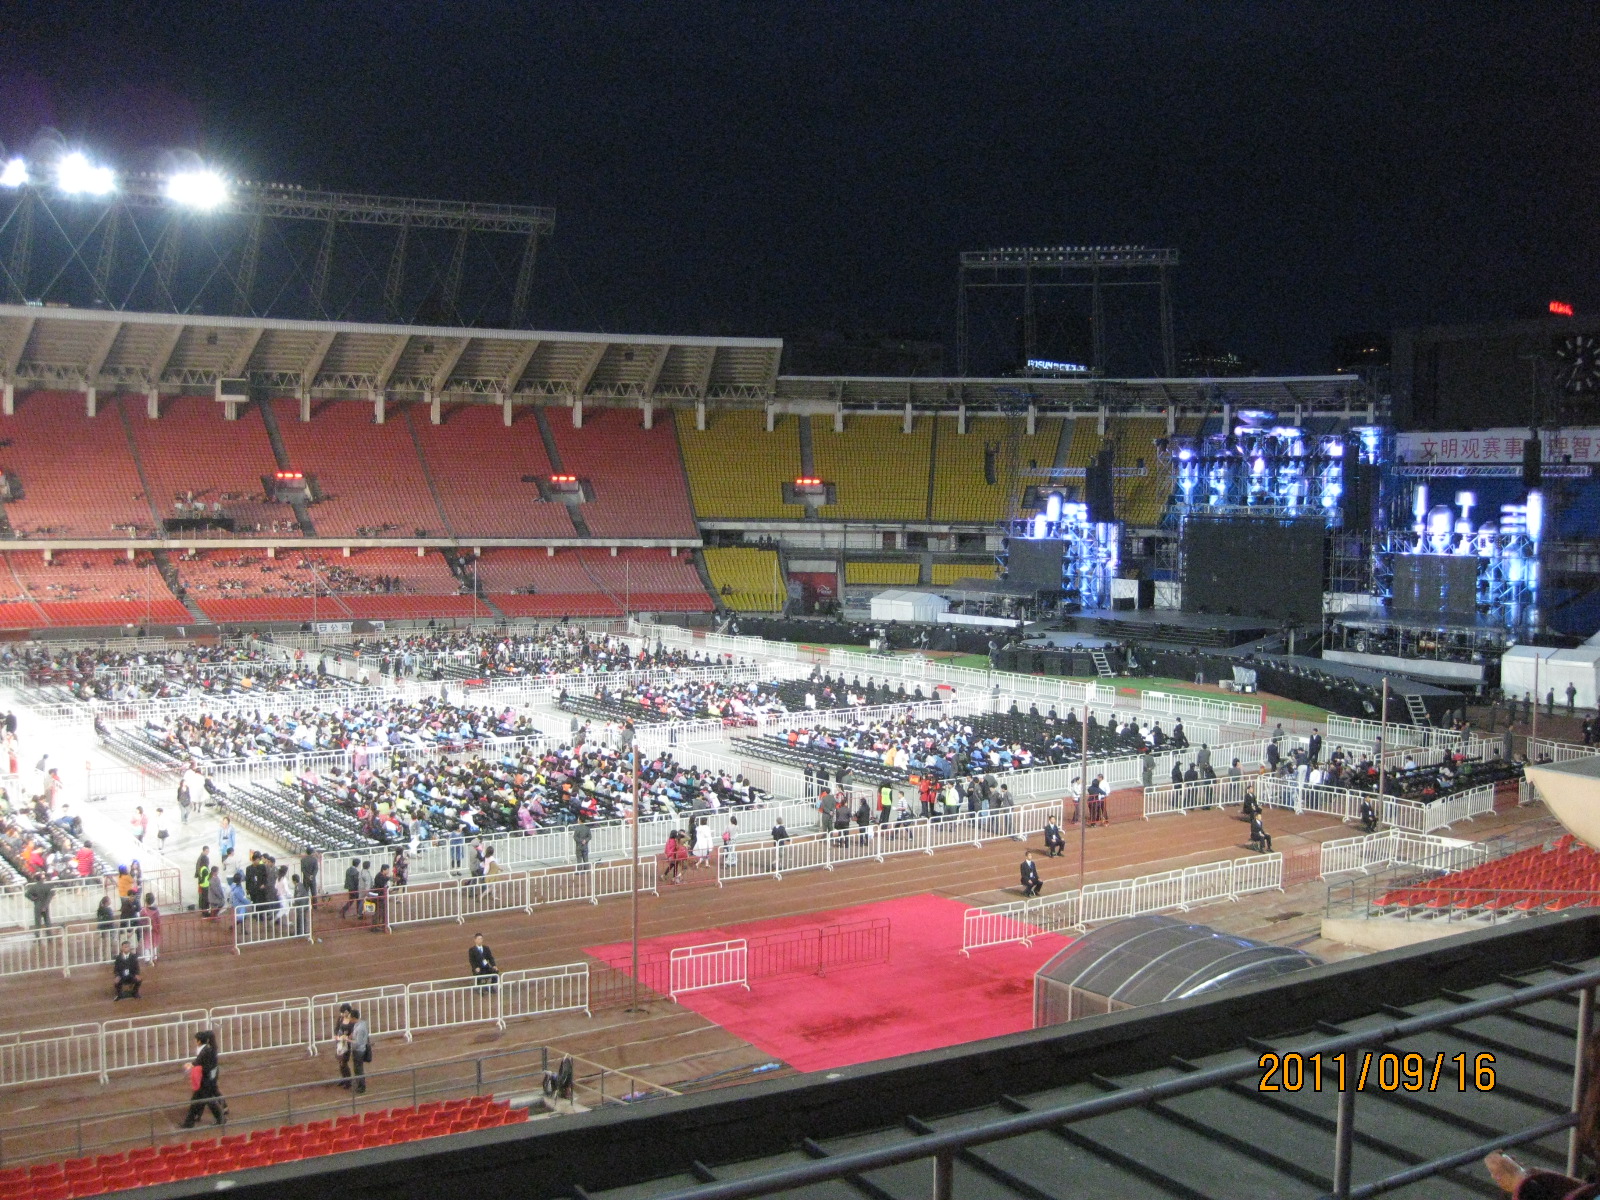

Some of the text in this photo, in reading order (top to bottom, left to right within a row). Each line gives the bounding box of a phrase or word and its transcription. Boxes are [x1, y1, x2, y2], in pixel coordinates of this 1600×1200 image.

[1421, 437, 1524, 460] 文明观赛事
